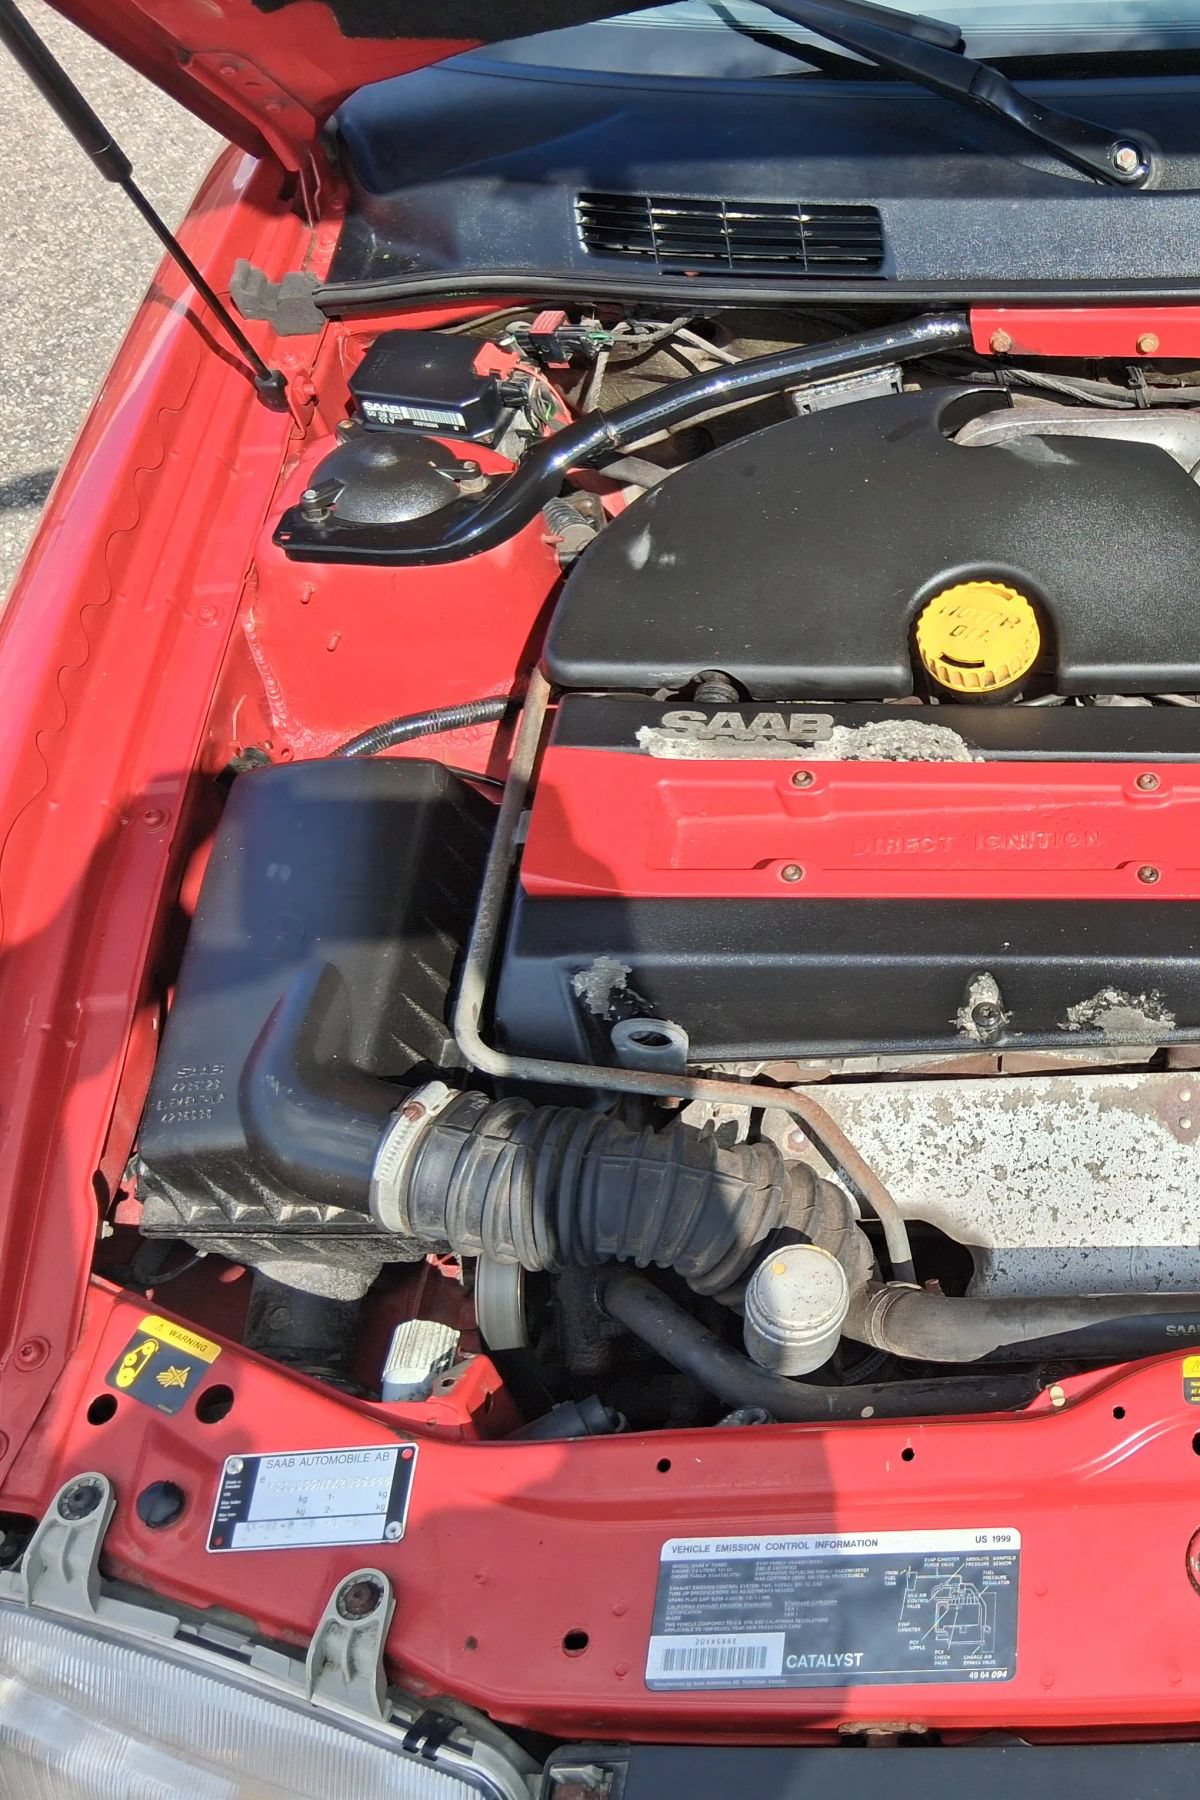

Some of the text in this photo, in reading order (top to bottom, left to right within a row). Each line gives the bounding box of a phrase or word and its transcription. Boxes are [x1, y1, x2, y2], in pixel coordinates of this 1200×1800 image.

[362, 401, 400, 414] SAAB
[662, 710, 834, 741] SAAB
[852, 832, 1102, 856] DIRECT IGNITION
[169, 1329, 208, 1352] WARNING
[266, 1452, 390, 1469] SAAB AUTOMOBILE AB
[299, 1494, 308, 1504] kg
[378, 1490, 388, 1499] kg
[296, 1507, 305, 1516] kg
[376, 1503, 386, 1512] kg
[672, 1545, 710, 1554] VEHICLE
[716, 1542, 760, 1552] EMISSION
[765, 1542, 809, 1551] CONTROL
[815, 1539, 878, 1549] INFORMATION
[786, 1652, 863, 1669] CATALYST
[969, 1671, 978, 1679] 49
